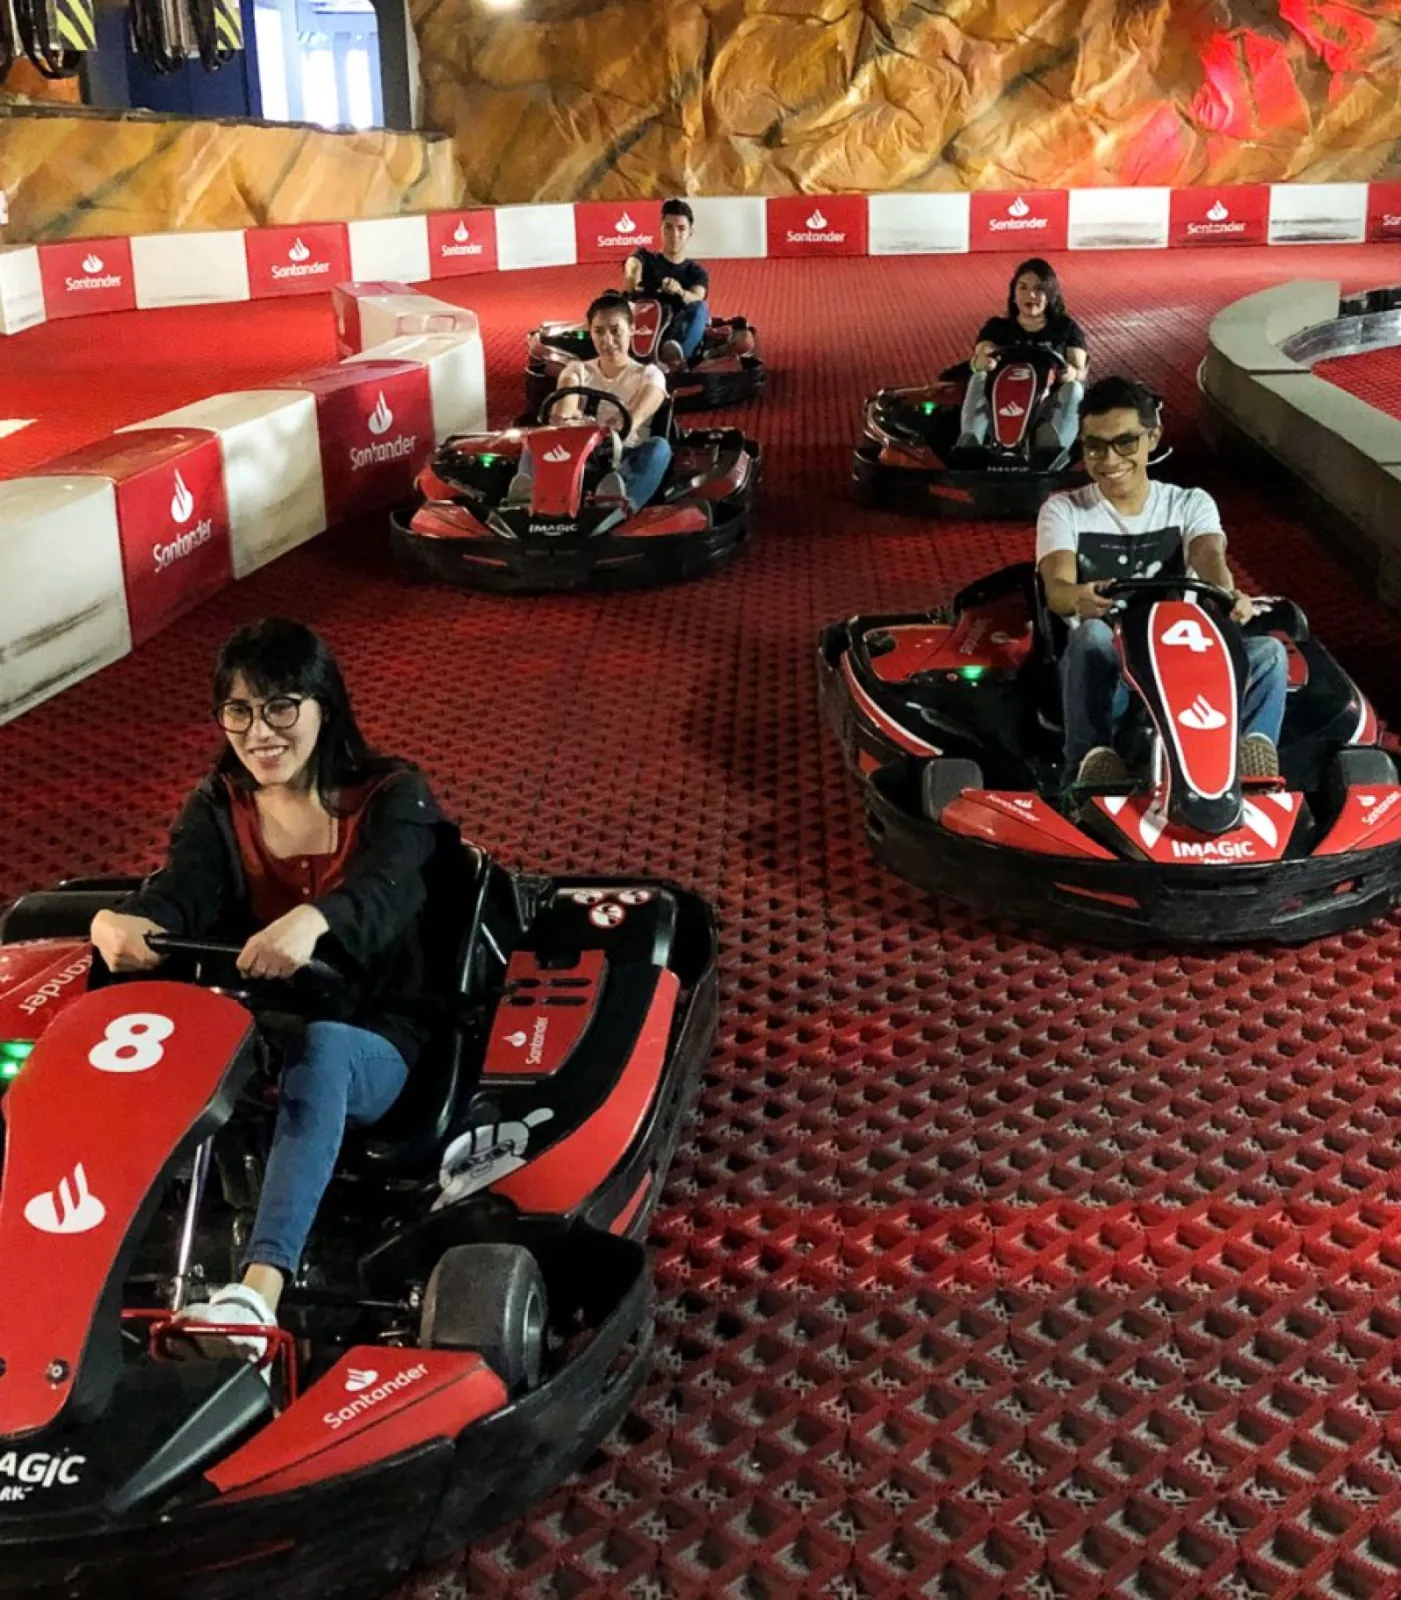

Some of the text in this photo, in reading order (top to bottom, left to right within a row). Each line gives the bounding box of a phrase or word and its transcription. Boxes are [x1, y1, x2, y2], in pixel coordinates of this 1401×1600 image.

[987, 215, 1048, 232] Santander
[1187, 221, 1246, 235] Santander
[597, 234, 654, 249] Santander
[786, 230, 846, 244] Santander
[441, 243, 483, 257] Santander
[271, 260, 330, 279] Santander
[65, 274, 122, 292] Santander
[350, 435, 417, 471] Santander
[153, 517, 212, 573] Santander
[1161, 620, 1215, 653] 4
[1171, 840, 1256, 859] IMAGIC
[88, 1012, 175, 1073] 8
[525, 1016, 549, 1065] Santander
[322, 1363, 429, 1429] Santander
[0, 1451, 86, 1488] AGIC
